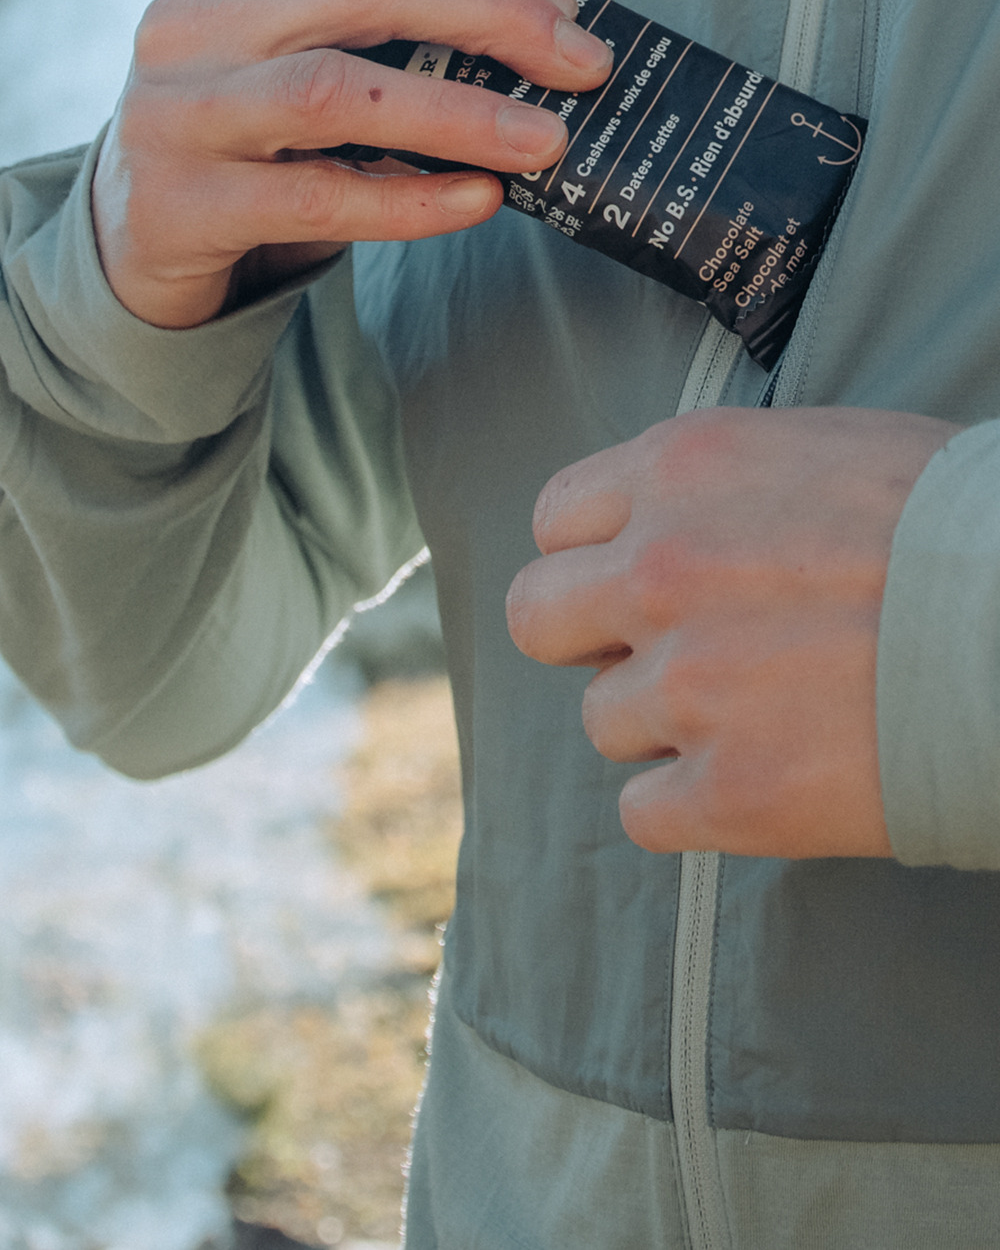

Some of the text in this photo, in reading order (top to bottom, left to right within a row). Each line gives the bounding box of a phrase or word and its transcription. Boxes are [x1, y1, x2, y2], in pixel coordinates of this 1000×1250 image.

[561, 36, 672, 205] 4 Cashews noix de cajou
[648, 70, 764, 249] No B.S. Rien d’absurd
[508, 188, 536, 212] BC15
[510, 180, 535, 203] 2025
[548, 206, 566, 221] 26
[603, 113, 680, 230] 2 Dates dattes
[699, 201, 754, 281] Chocolate
[713, 226, 763, 292] Sea Salt
[735, 217, 801, 307] Chocolat et
[786, 239, 808, 272] mer
